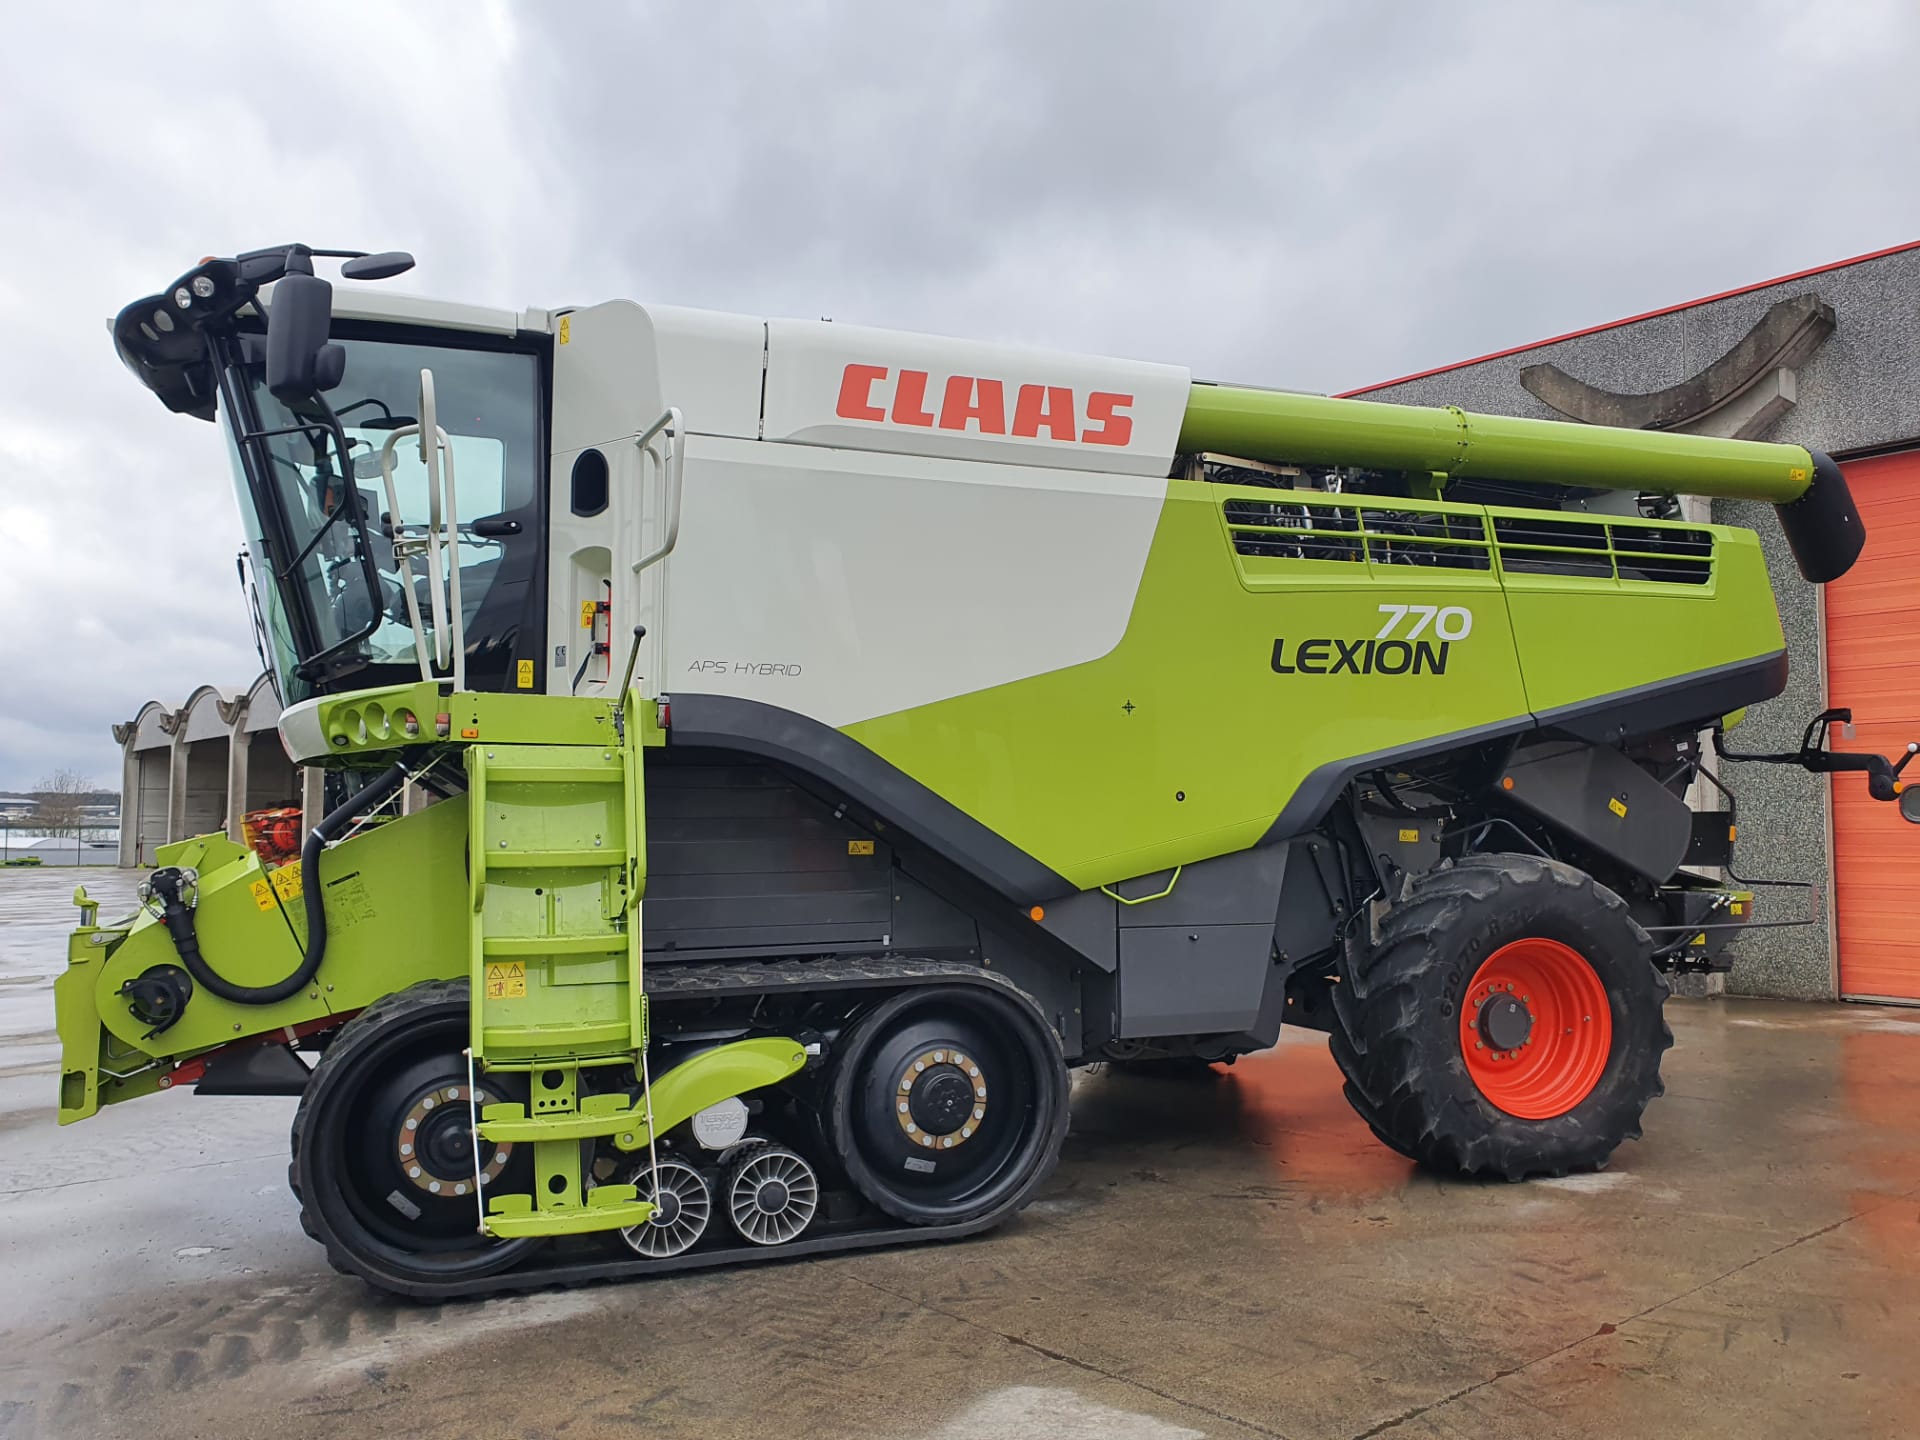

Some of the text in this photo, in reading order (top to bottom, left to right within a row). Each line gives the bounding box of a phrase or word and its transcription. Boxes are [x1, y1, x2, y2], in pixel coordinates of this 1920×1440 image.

[836, 363, 1134, 446] CLAAS
[1375, 604, 1473, 641] 770
[687, 660, 803, 677] APS HYBRID
[1271, 638, 1450, 675] LEXION
[699, 1111, 742, 1123] TERRA
[704, 1120, 740, 1132] TRAC
